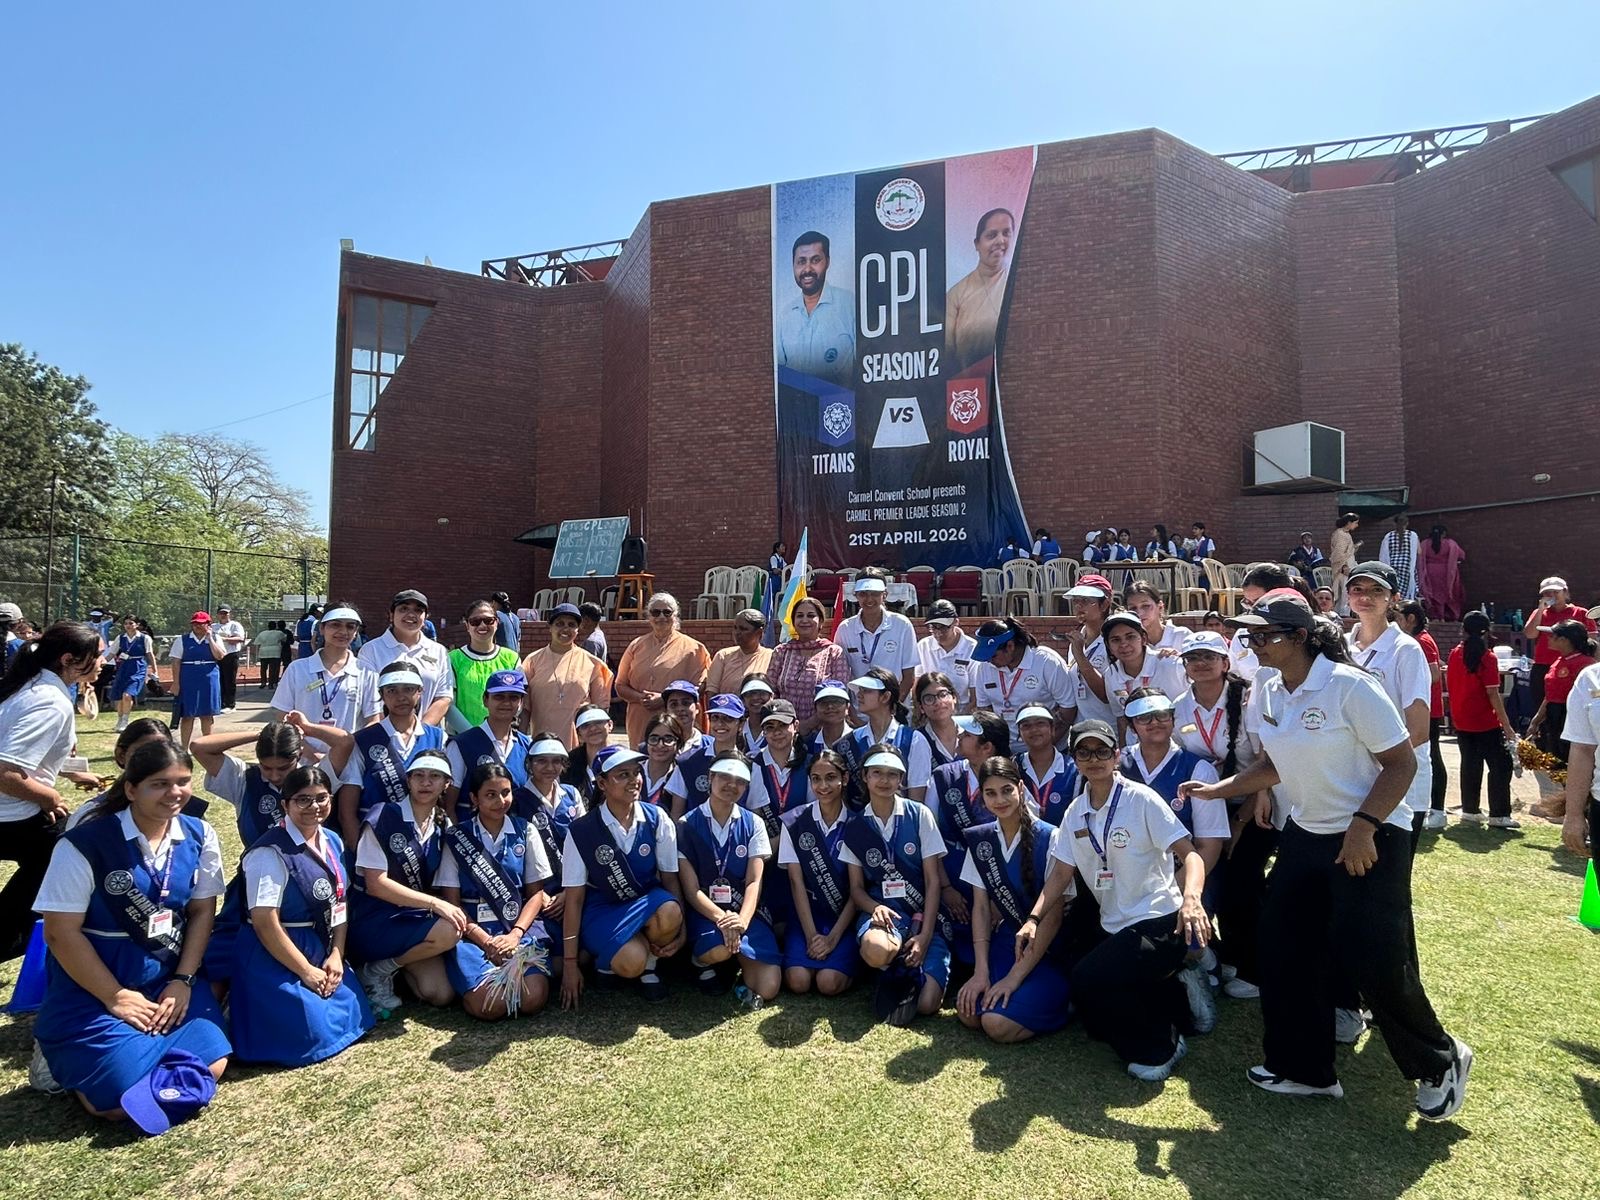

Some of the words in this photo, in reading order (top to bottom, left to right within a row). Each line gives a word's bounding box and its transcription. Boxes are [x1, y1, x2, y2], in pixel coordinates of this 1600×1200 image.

[860, 248, 942, 338] CPL
[862, 349, 925, 384] SEASON
[928, 348, 940, 378] 2
[889, 406, 914, 424] VS
[812, 452, 856, 475] TITANS
[948, 438, 990, 463] ROYAL
[848, 490, 873, 504] Carmel
[874, 488, 904, 502] Convent
[906, 486, 931, 501] School
[932, 484, 966, 501] presents
[846, 509, 872, 523] CARMEL
[874, 506, 904, 521] PREMIER
[906, 505, 930, 519] LEAGUE
[932, 503, 959, 518] SEASON
[961, 502, 966, 516] 2
[848, 532, 881, 546] 21ST
[883, 530, 926, 545] APRIL
[929, 528, 967, 543] 2026
[454, 830, 476, 854] CARMEL
[472, 851, 498, 878] CONVENT
[492, 876, 512, 902] SCHOOL
[609, 860, 628, 888] CARMEL
[811, 846, 828, 874] CARMEL
[823, 872, 843, 902] CONVENT
[988, 856, 1002, 886] CARMEL
